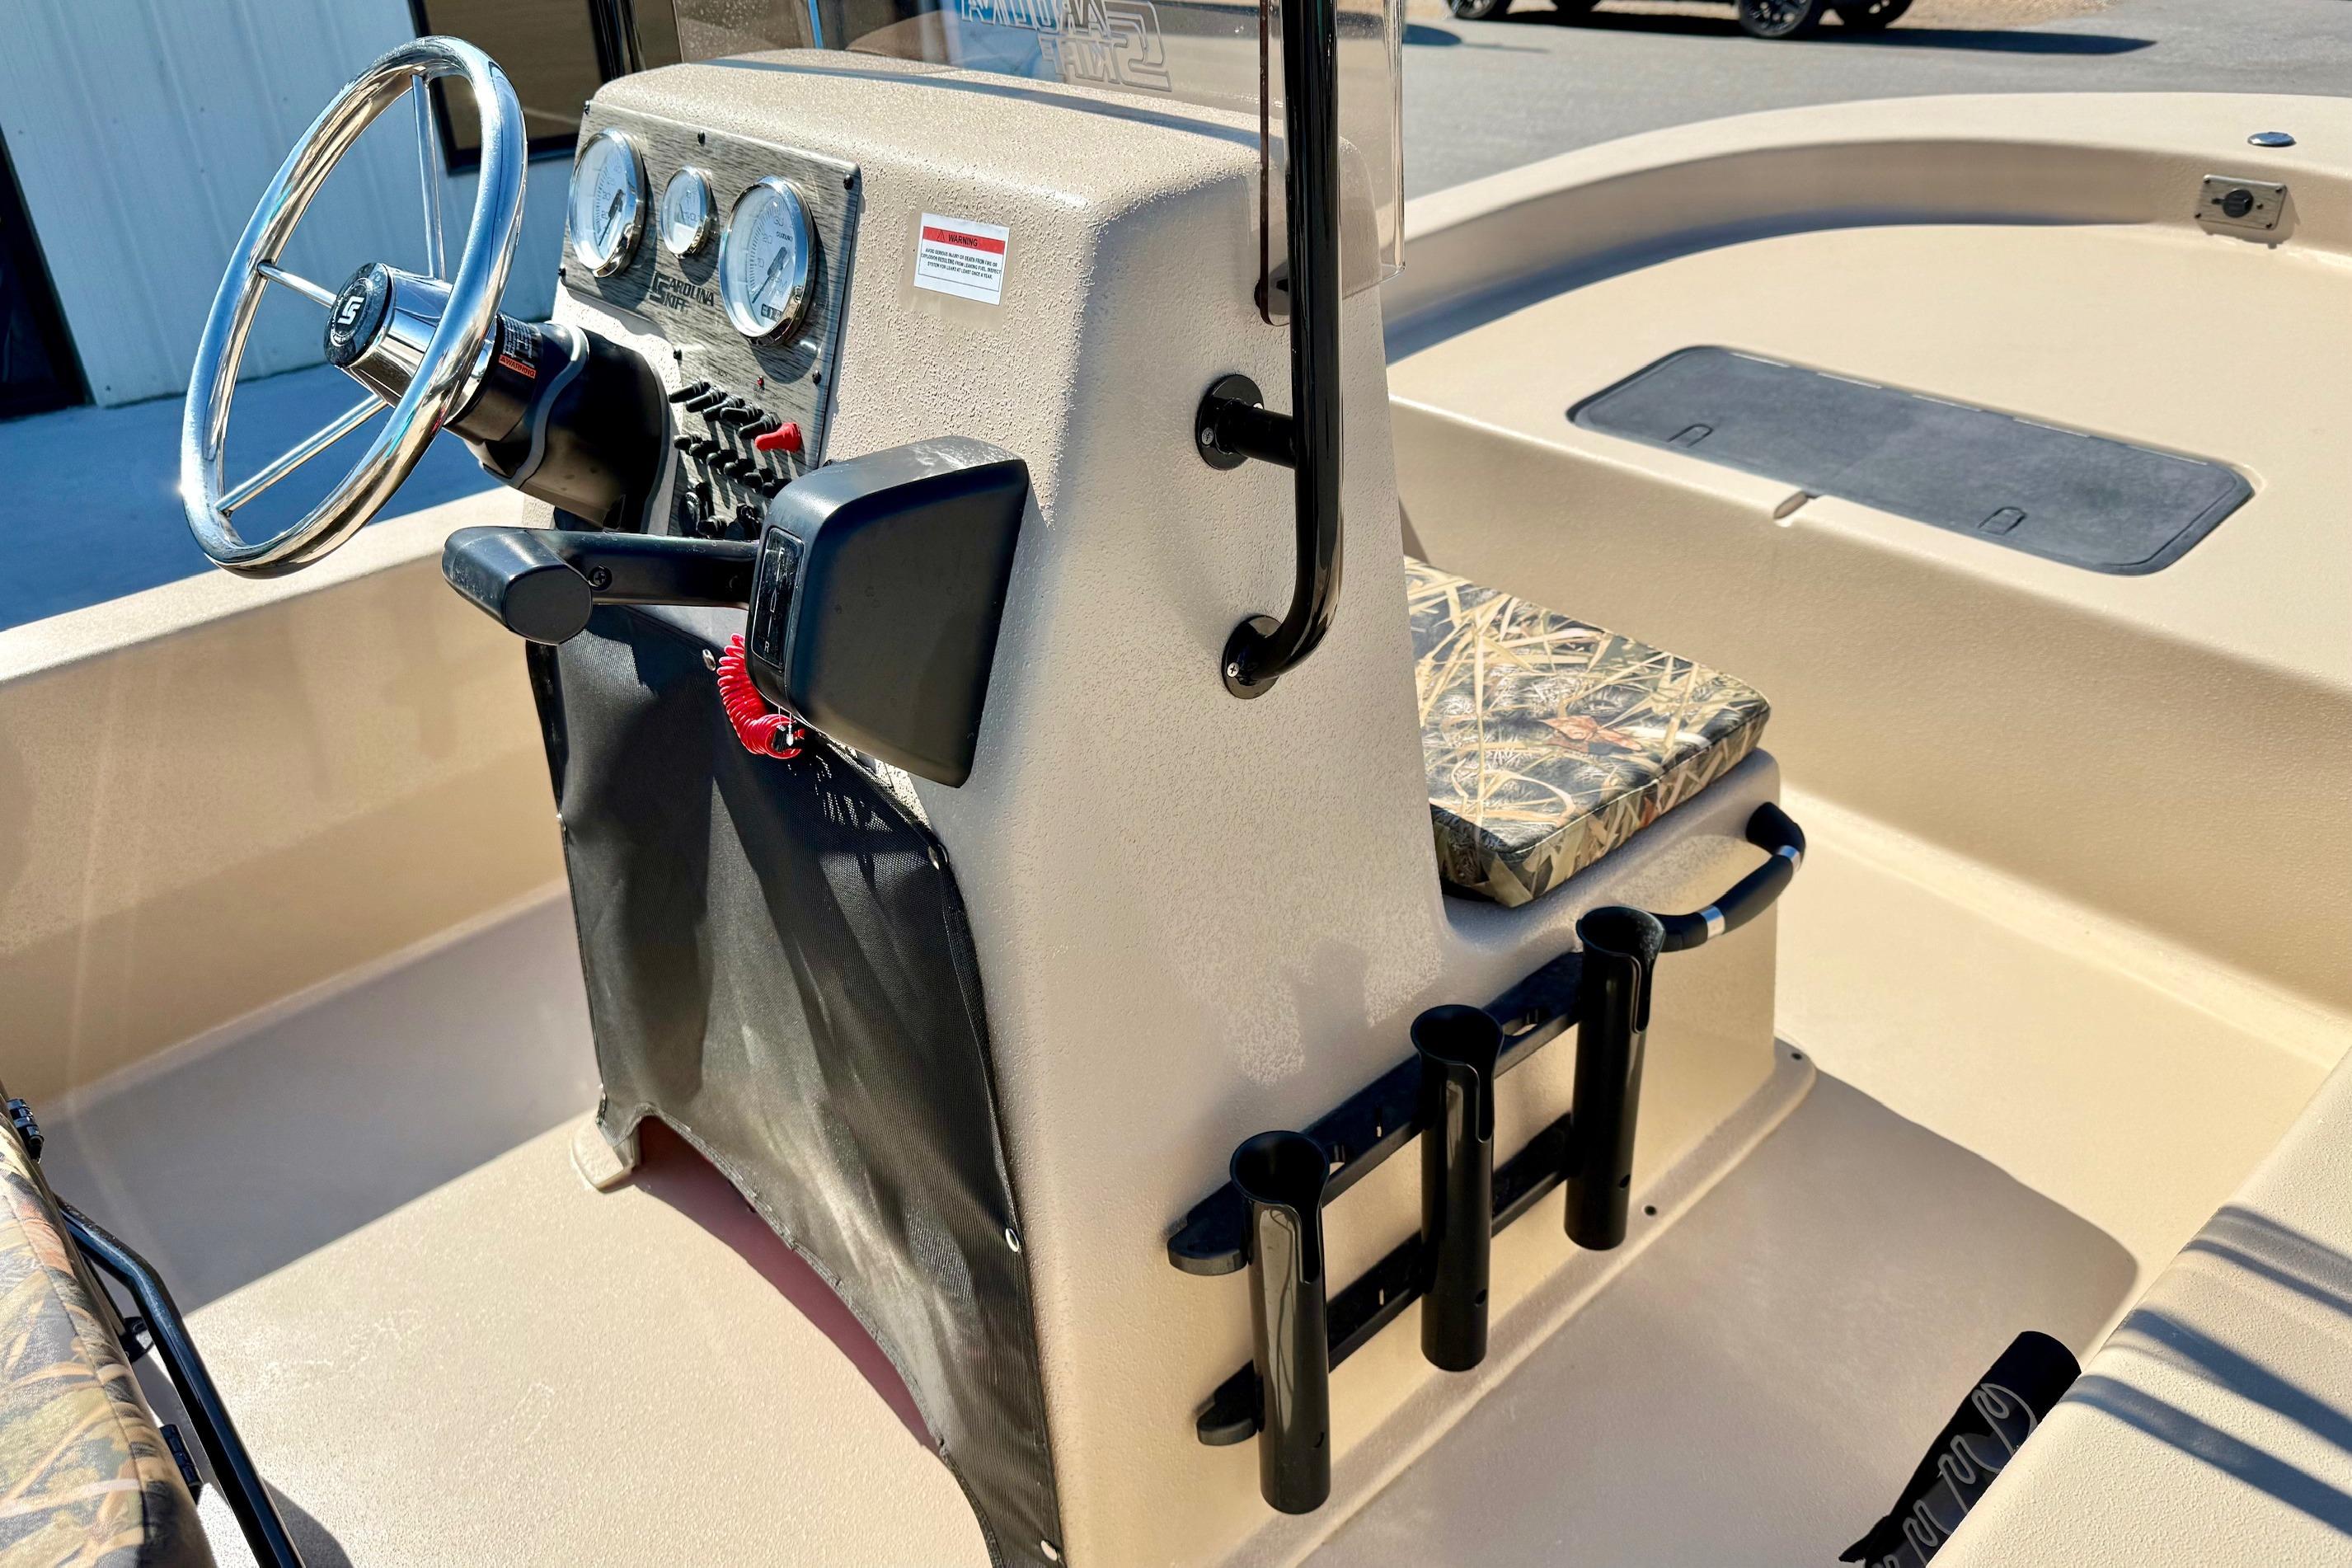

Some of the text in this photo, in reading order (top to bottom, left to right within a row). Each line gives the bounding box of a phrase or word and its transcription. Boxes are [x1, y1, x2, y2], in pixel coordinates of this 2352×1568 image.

[948, 233, 978, 246] WARNING
[652, 272, 714, 307] CAROLINA
[505, 358, 535, 377] WARNING
[778, 547, 786, 560] F
[763, 641, 770, 653] R
